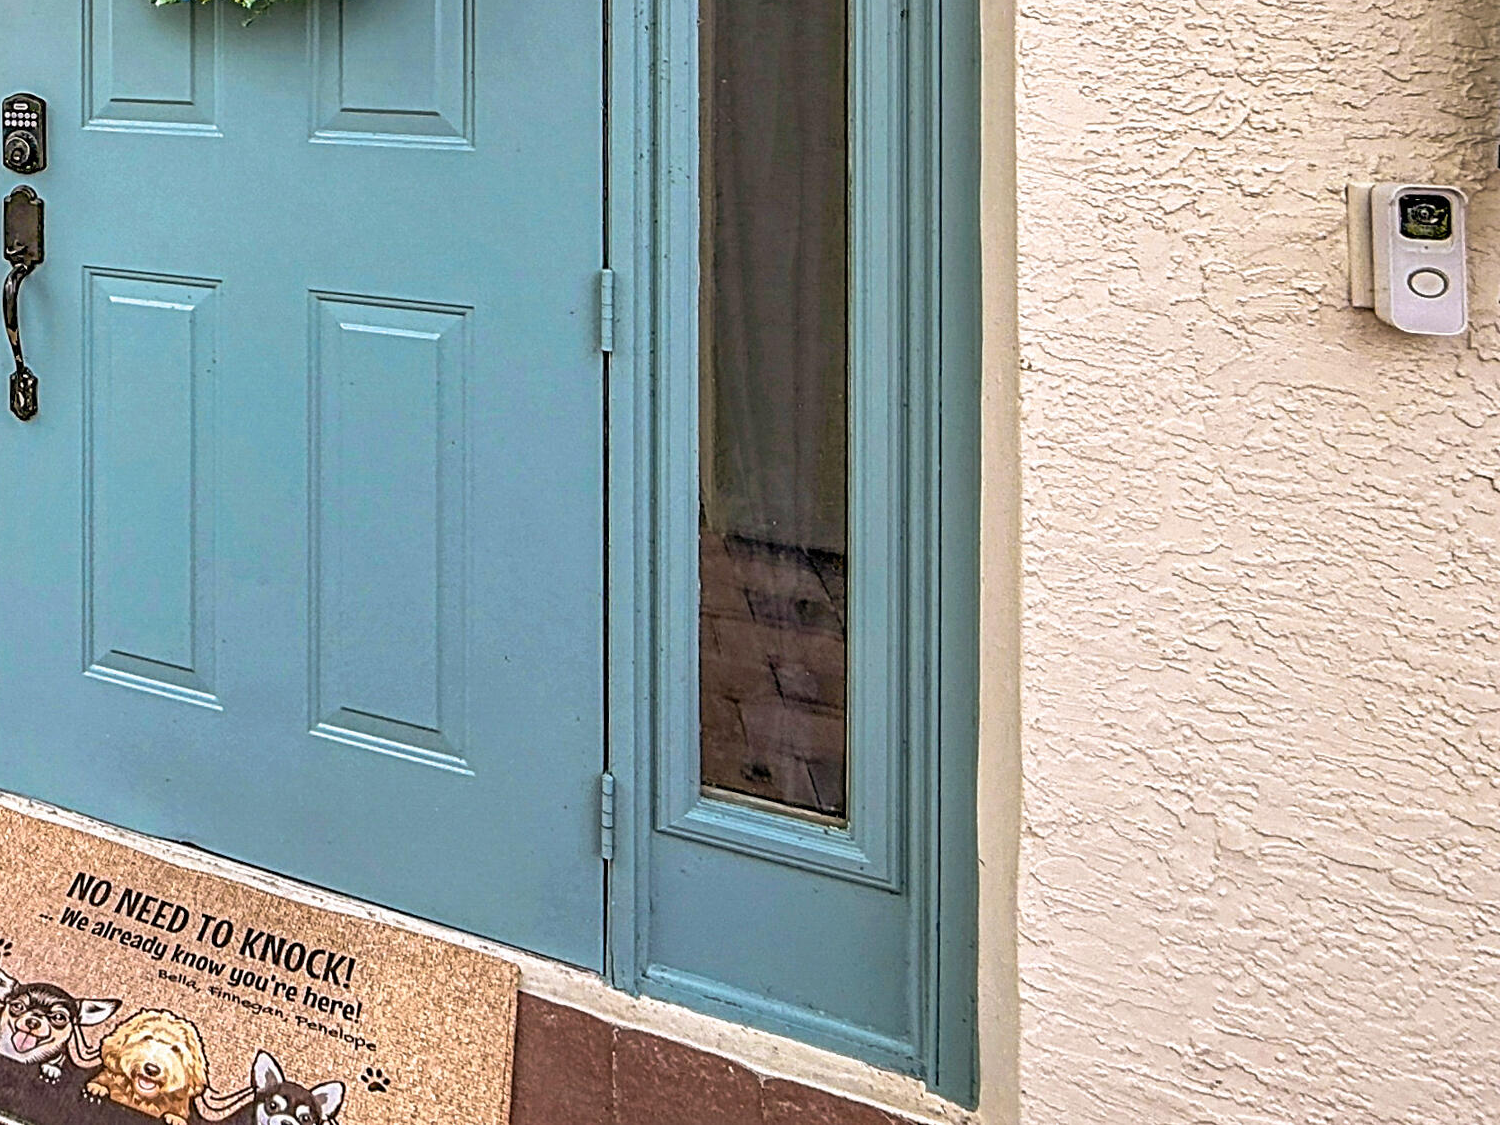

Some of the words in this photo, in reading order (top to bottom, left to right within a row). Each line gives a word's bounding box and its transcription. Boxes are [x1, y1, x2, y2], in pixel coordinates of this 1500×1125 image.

[60, 908, 90, 931] We
[91, 921, 168, 961] already
[170, 943, 226, 977] know
[227, 966, 298, 1002] you're
[302, 985, 363, 1024] here!
[66, 872, 112, 907] NO
[114, 887, 190, 933] NEED
[196, 913, 234, 948] TO
[239, 927, 357, 989] KNOCK!
[157, 969, 202, 993] Bella,
[295, 1015, 377, 1052] Penelope
